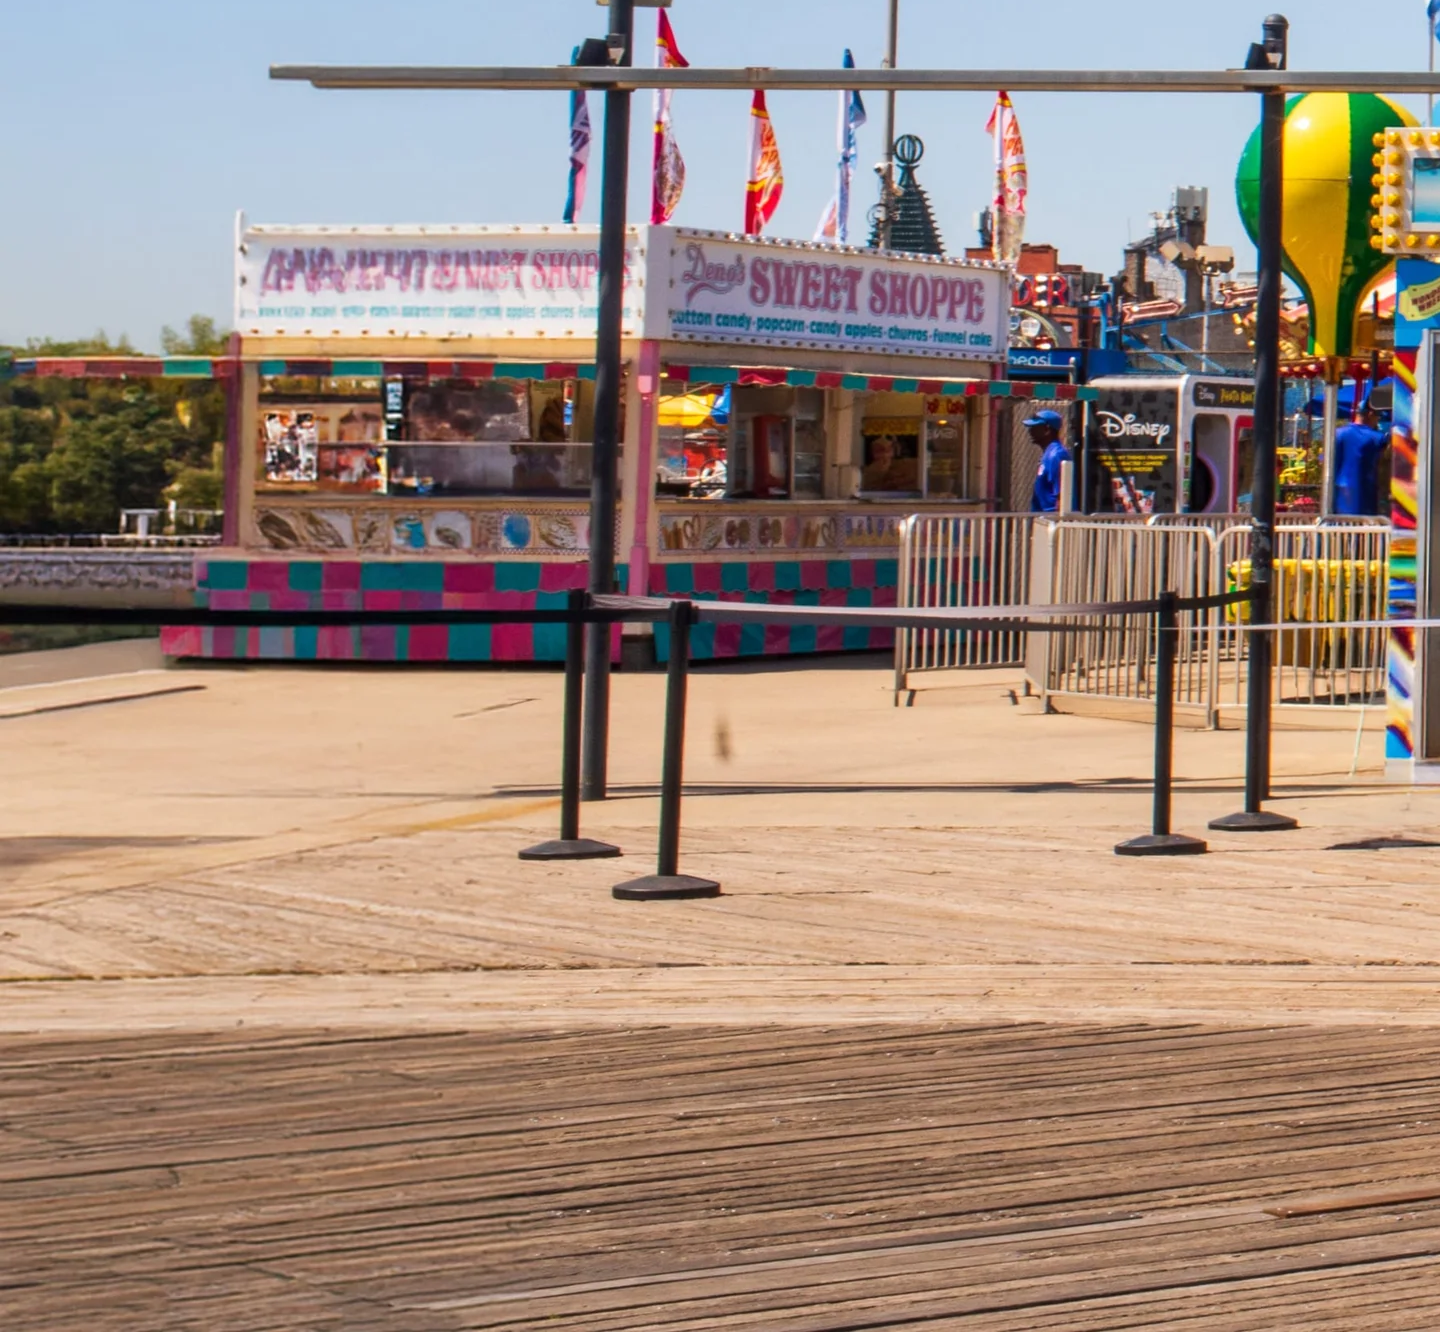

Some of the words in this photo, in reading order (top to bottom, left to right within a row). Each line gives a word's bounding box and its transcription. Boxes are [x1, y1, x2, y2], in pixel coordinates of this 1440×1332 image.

[682, 242, 746, 305] Deno's
[750, 255, 864, 314] SWEET
[869, 269, 986, 326] SHOPPE
[716, 313, 752, 331] candy
[756, 314, 804, 334] popcorn
[810, 320, 842, 338] candy
[888, 324, 929, 342] churros
